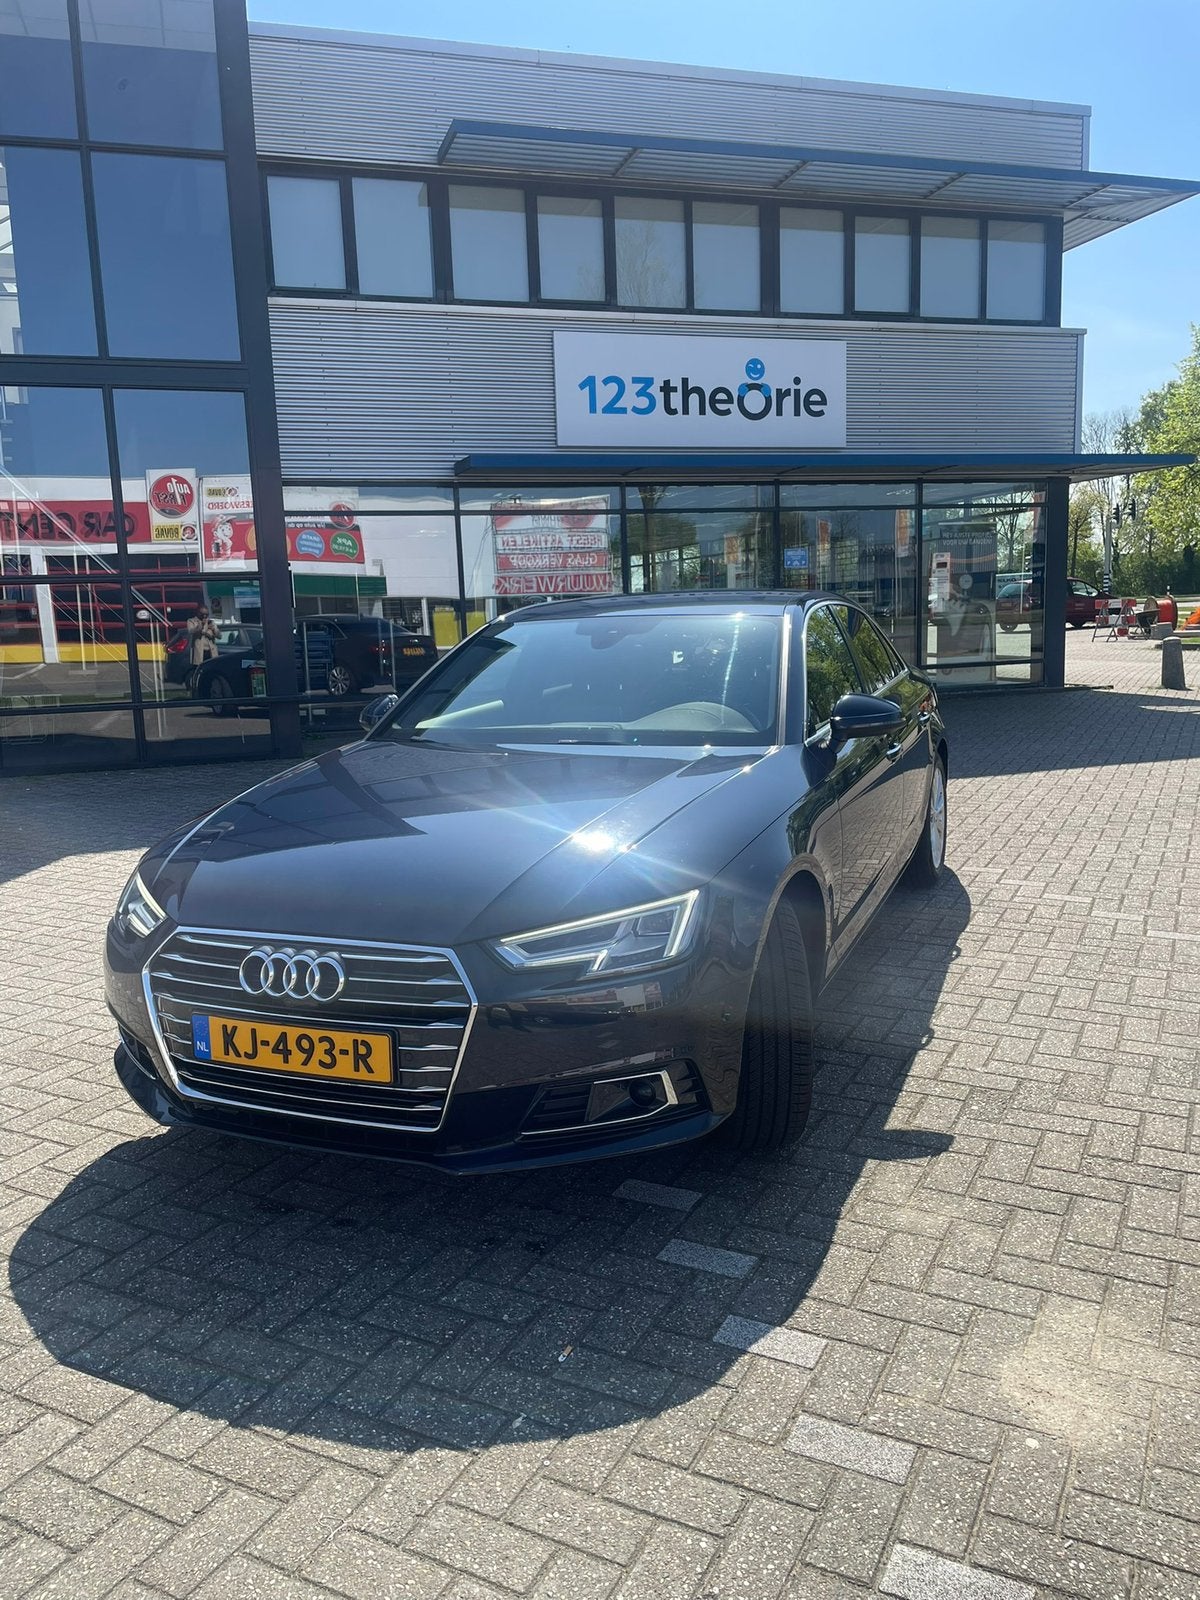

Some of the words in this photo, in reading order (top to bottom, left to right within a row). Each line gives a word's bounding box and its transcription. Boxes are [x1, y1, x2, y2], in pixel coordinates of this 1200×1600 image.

[578, 374, 828, 421] 123theorie
[197, 1041, 209, 1052] NL
[221, 1023, 375, 1074] KJ-493-R
